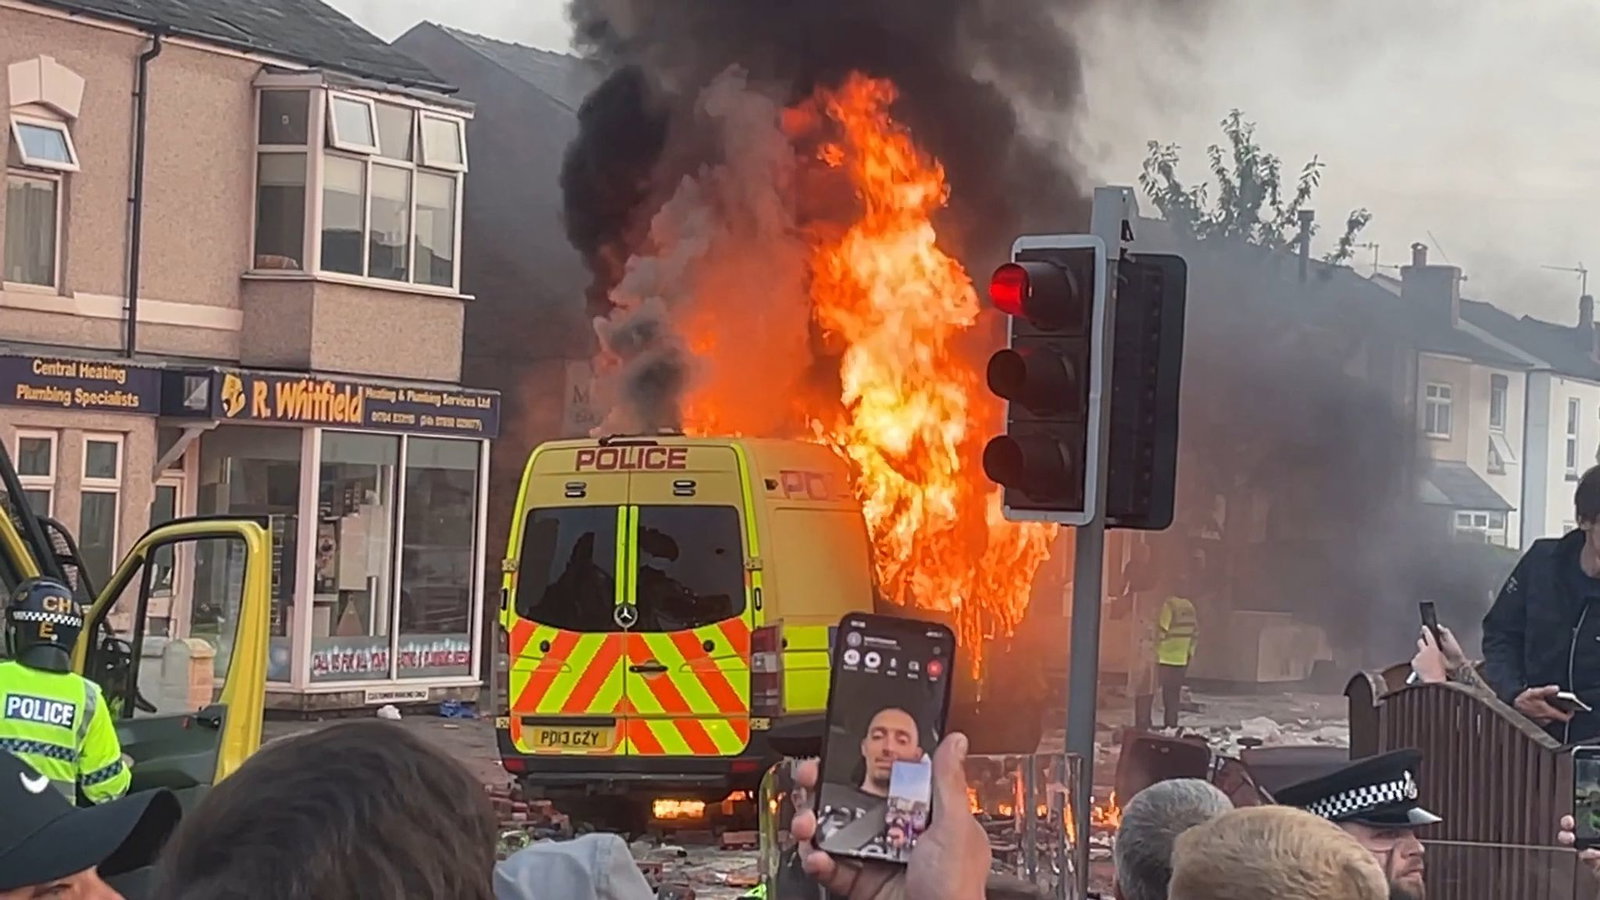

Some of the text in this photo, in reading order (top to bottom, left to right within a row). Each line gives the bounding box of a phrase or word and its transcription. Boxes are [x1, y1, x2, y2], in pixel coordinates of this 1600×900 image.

[32, 359, 127, 385] Central Heating
[15, 384, 140, 408] Plumbing Specialists
[251, 379, 364, 424] R. Whitfield
[398, 389, 405, 401] &
[442, 393, 476, 408] Services
[477, 397, 492, 409] Ltd
[575, 447, 689, 472] POLICE
[42, 595, 72, 614] CH
[38, 621, 55, 640] E
[7, 696, 75, 726] POLICE
[573, 730, 600, 745] GZY
